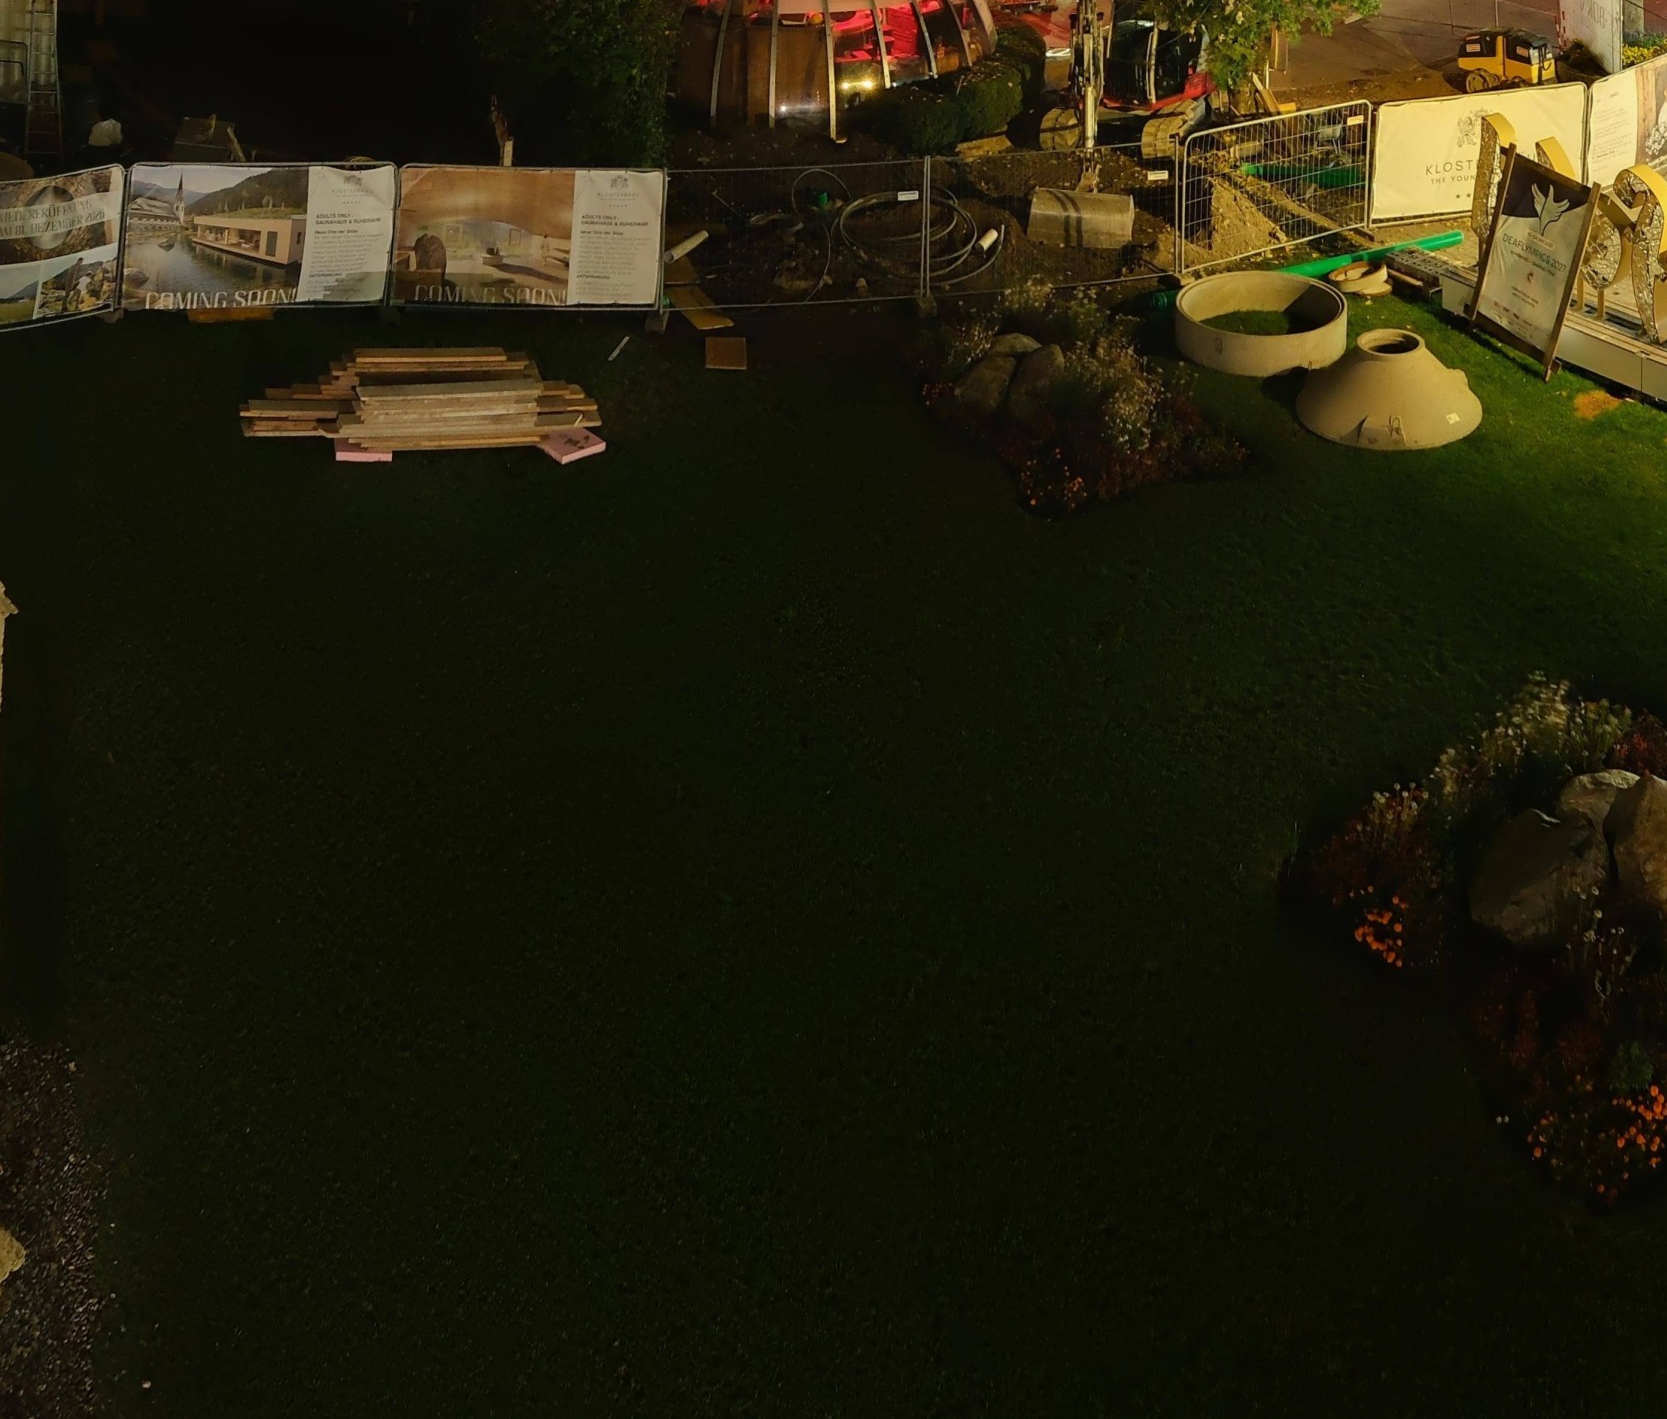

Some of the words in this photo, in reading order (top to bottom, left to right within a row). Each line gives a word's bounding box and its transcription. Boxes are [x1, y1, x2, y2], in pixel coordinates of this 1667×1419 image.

[1425, 159, 1479, 176] KLOST
[1431, 177, 1446, 185] THE
[1451, 174, 1476, 182] YOUN
[1502, 232, 1551, 265] DEAFLYMPICS
[1549, 257, 1567, 273] 2027
[146, 290, 227, 309] COMING
[234, 288, 298, 307] SOON!
[415, 284, 497, 303] COMING
[503, 287, 567, 306] SOON!
